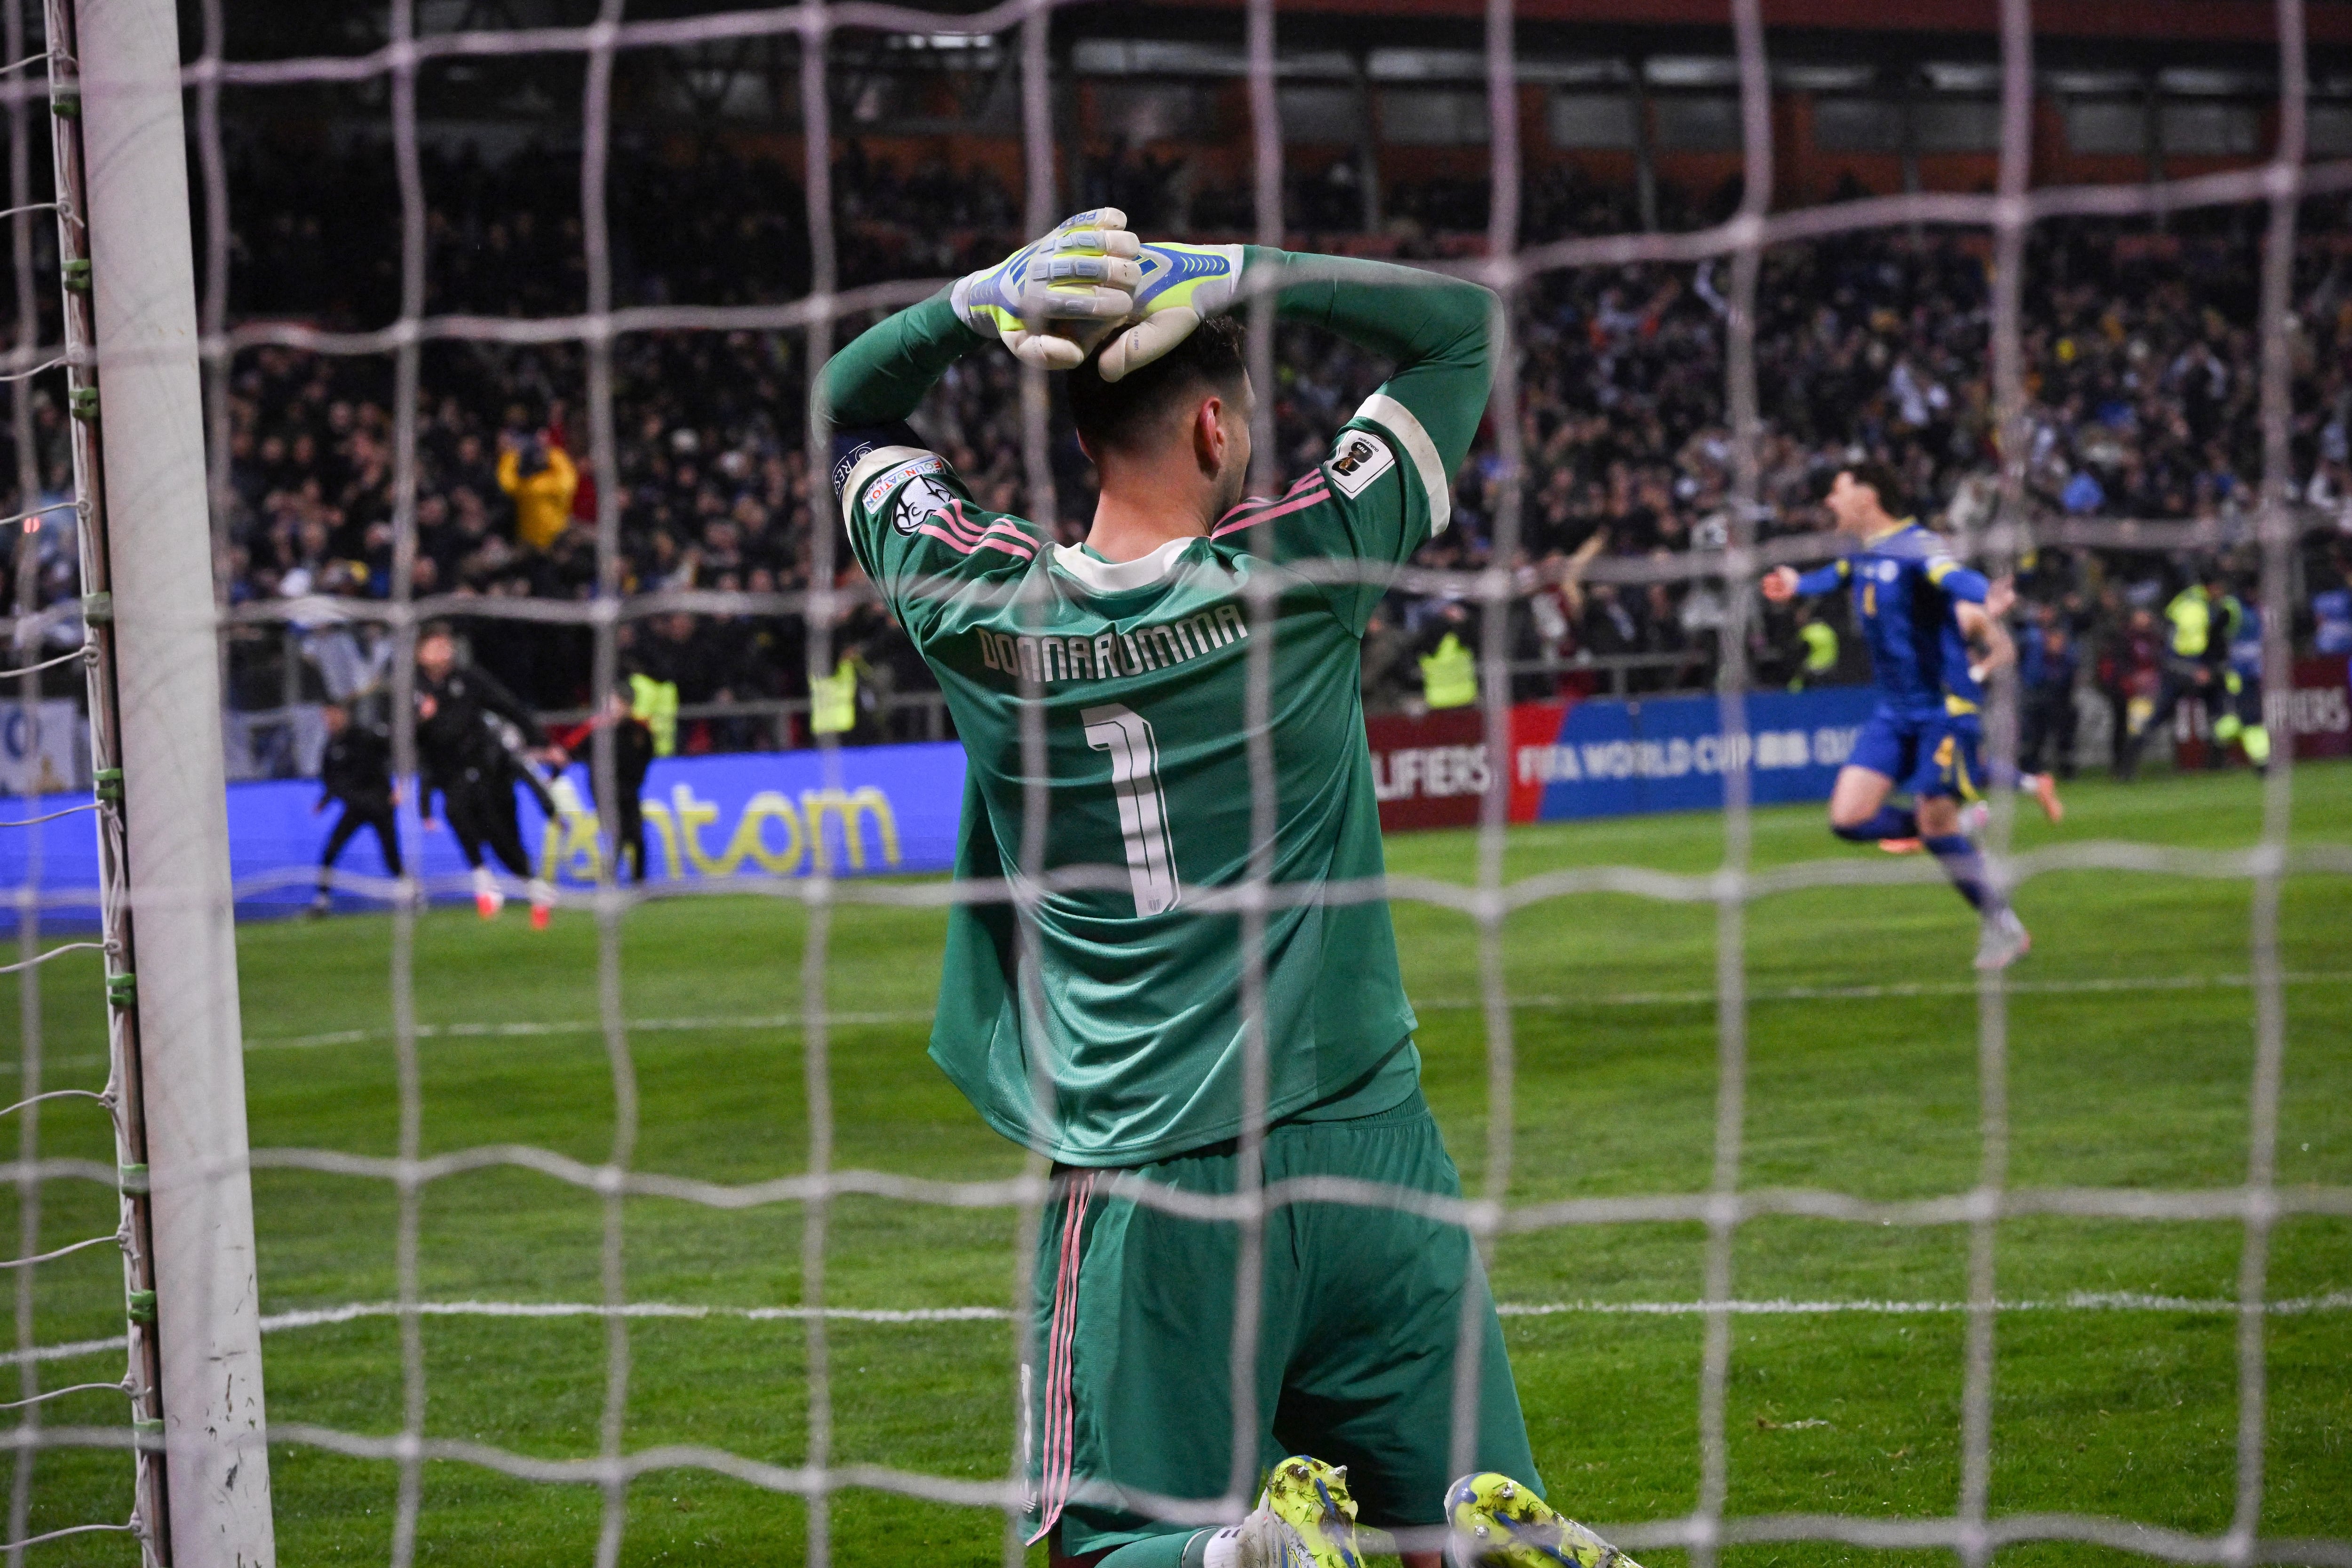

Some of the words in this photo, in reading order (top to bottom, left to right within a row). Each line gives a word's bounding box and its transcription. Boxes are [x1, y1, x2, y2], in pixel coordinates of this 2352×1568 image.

[1357, 444, 1367, 454] FIFA
[1358, 437, 1379, 452] QUALIFIERS
[976, 604, 1248, 682] DONNARUMMA
[1581, 737, 1693, 780] WORLD
[1080, 702, 1181, 918] 1
